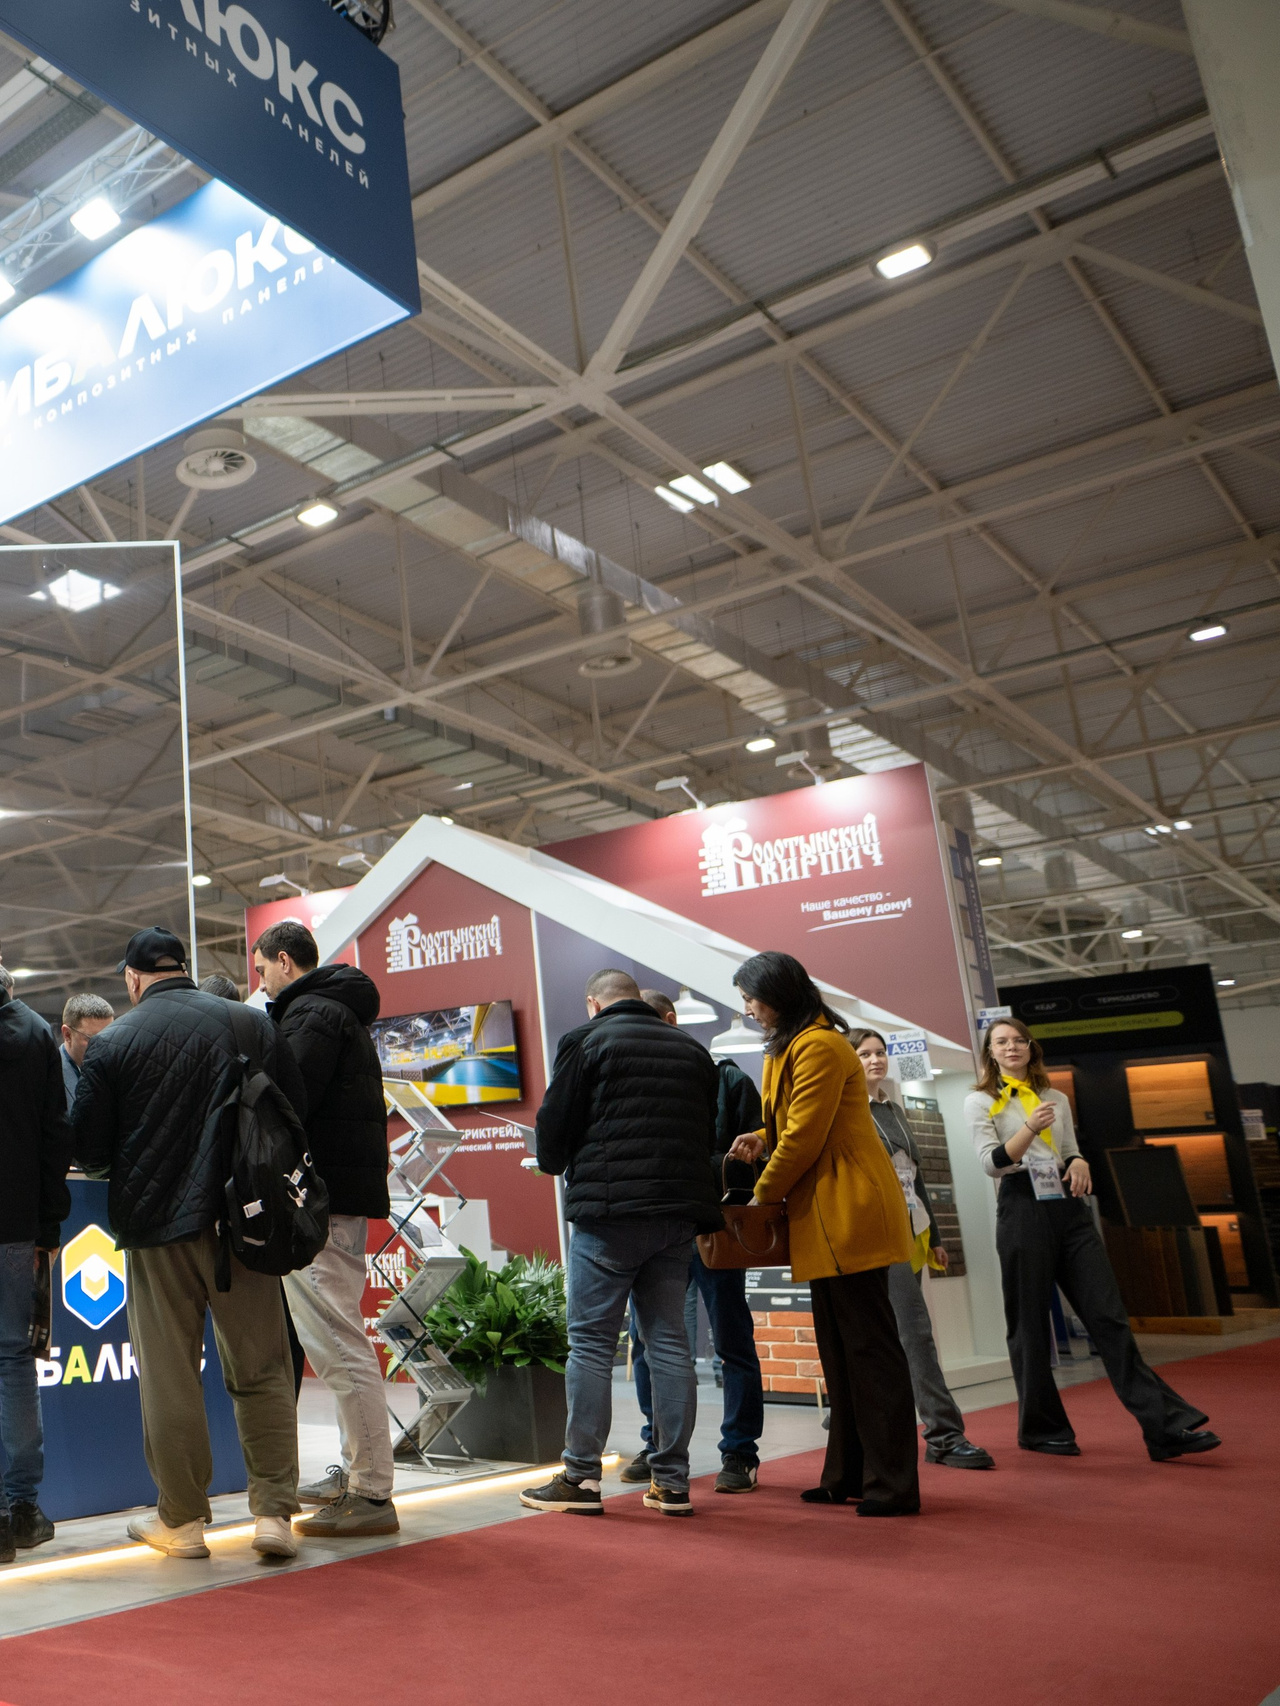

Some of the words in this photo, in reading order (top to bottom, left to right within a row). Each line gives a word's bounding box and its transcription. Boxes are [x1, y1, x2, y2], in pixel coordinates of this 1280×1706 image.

[264, 97, 369, 189] ПАНЕЛЕЙ
[34, 328, 198, 430] КОМПОЗИТНЫХ
[801, 901, 831, 913] Наше
[833, 892, 883, 909] качество
[823, 905, 873, 921] Вашему
[875, 897, 912, 915] дому!
[891, 1041, 925, 1055] A329
[437, 1141, 492, 1155] кермический
[495, 1140, 525, 1152] кирпич
